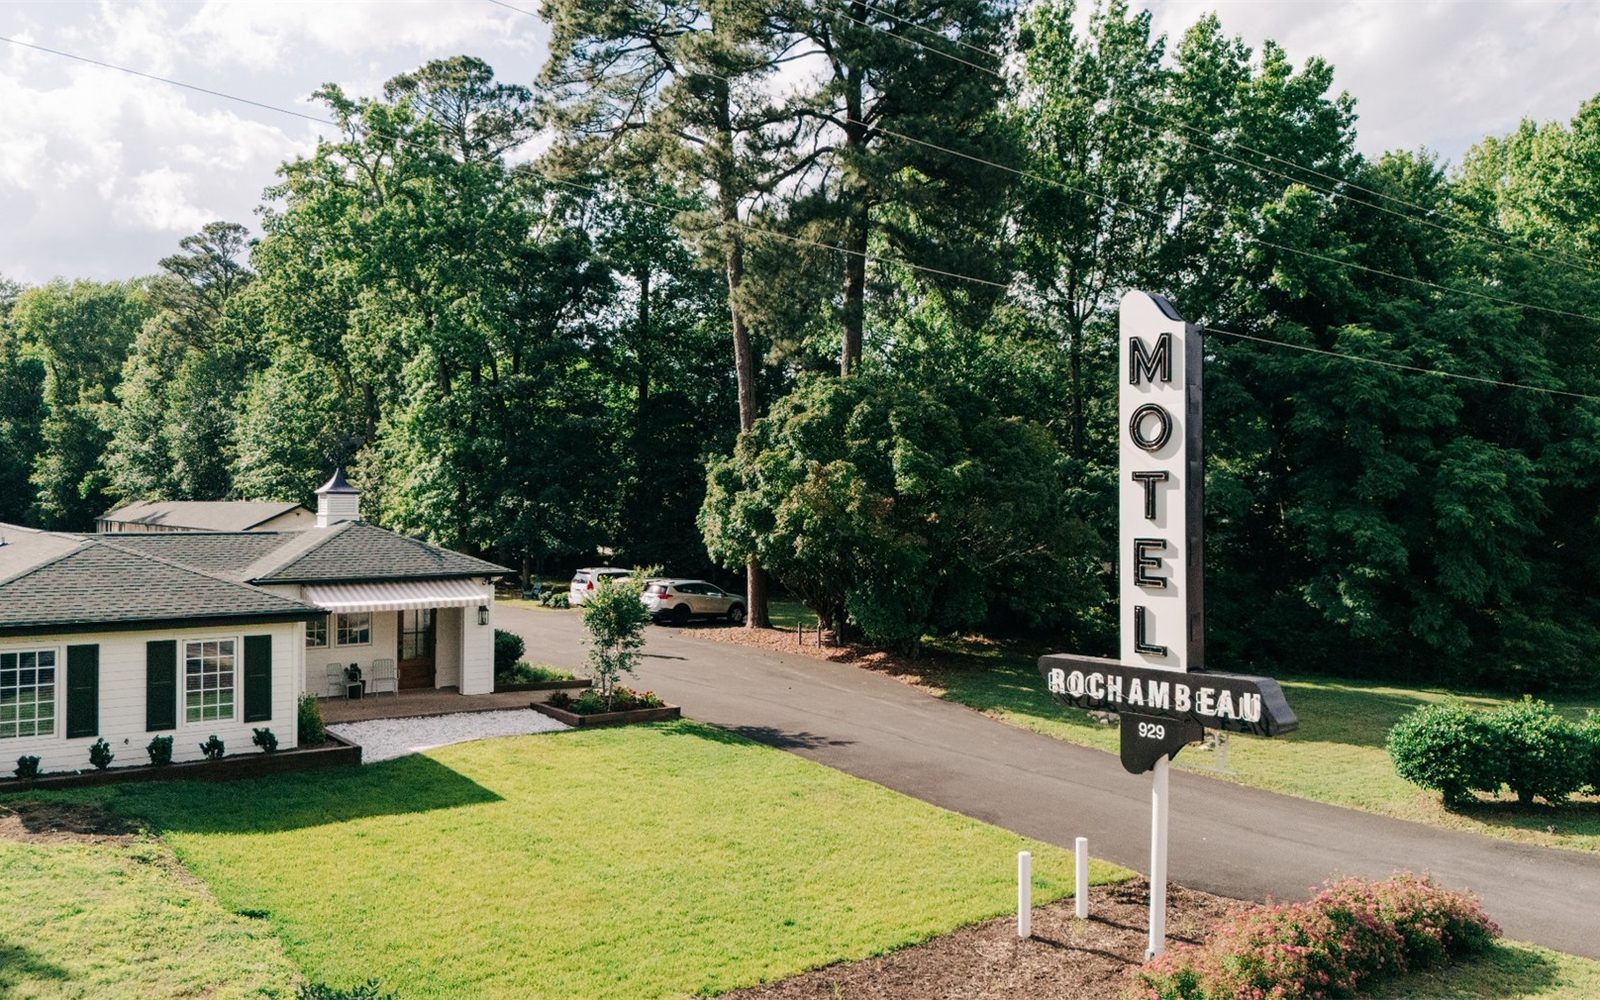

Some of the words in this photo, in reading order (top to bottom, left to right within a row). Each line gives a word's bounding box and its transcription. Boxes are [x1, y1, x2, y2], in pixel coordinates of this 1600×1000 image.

[1129, 332, 1173, 658] MOTEL
[1048, 668, 1262, 722] ROCHAMBEAU
[1138, 722, 1165, 740] 929
